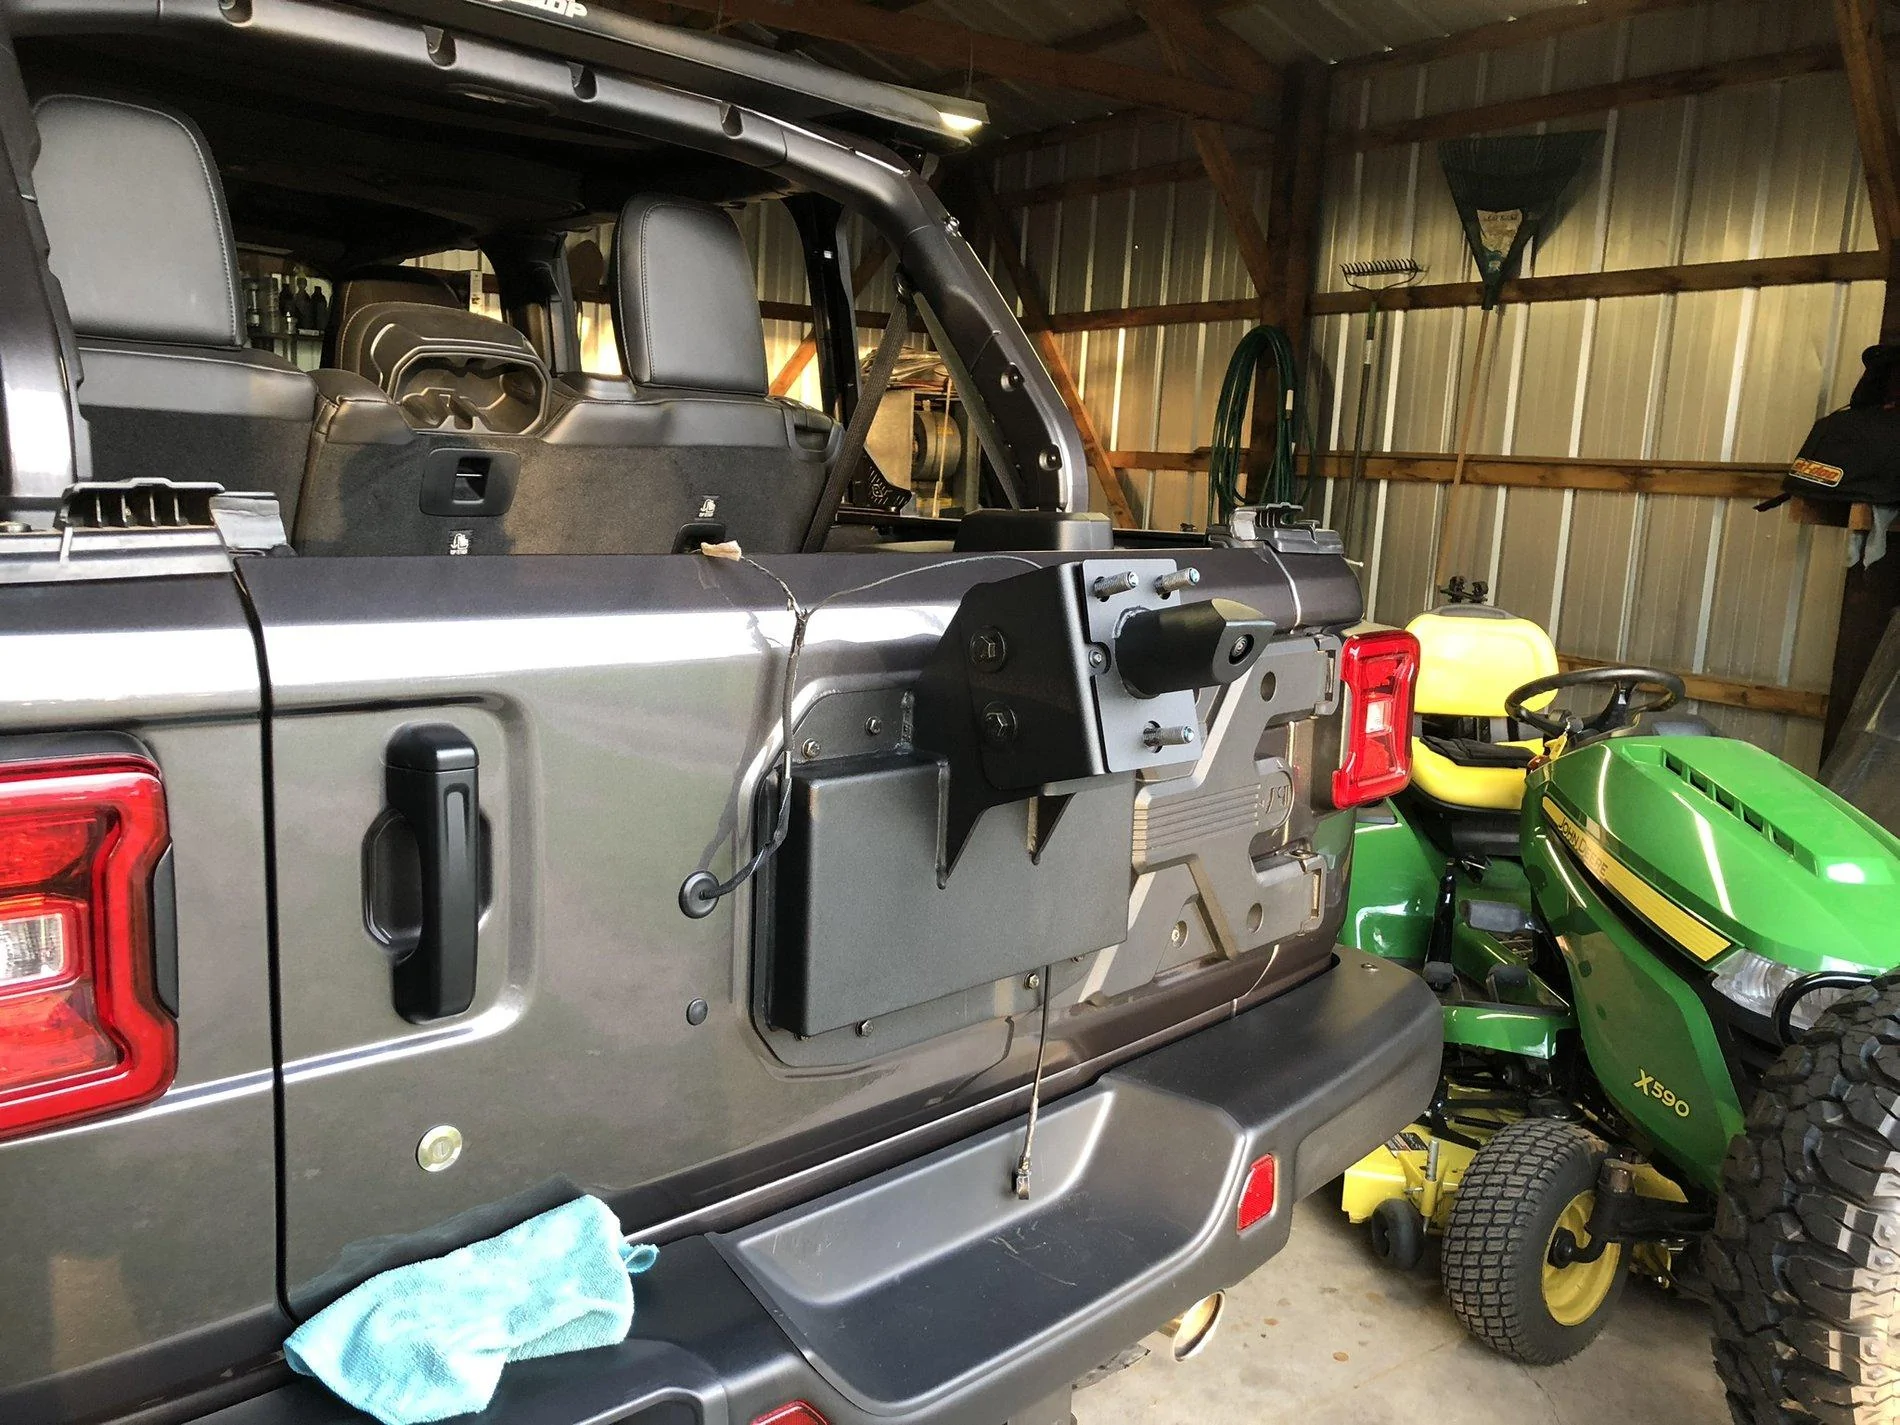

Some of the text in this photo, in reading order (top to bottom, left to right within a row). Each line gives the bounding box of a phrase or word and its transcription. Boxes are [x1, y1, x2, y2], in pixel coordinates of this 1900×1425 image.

[1557, 817, 1609, 877] JOHN DEERE
[1633, 1068, 1690, 1117] X590
